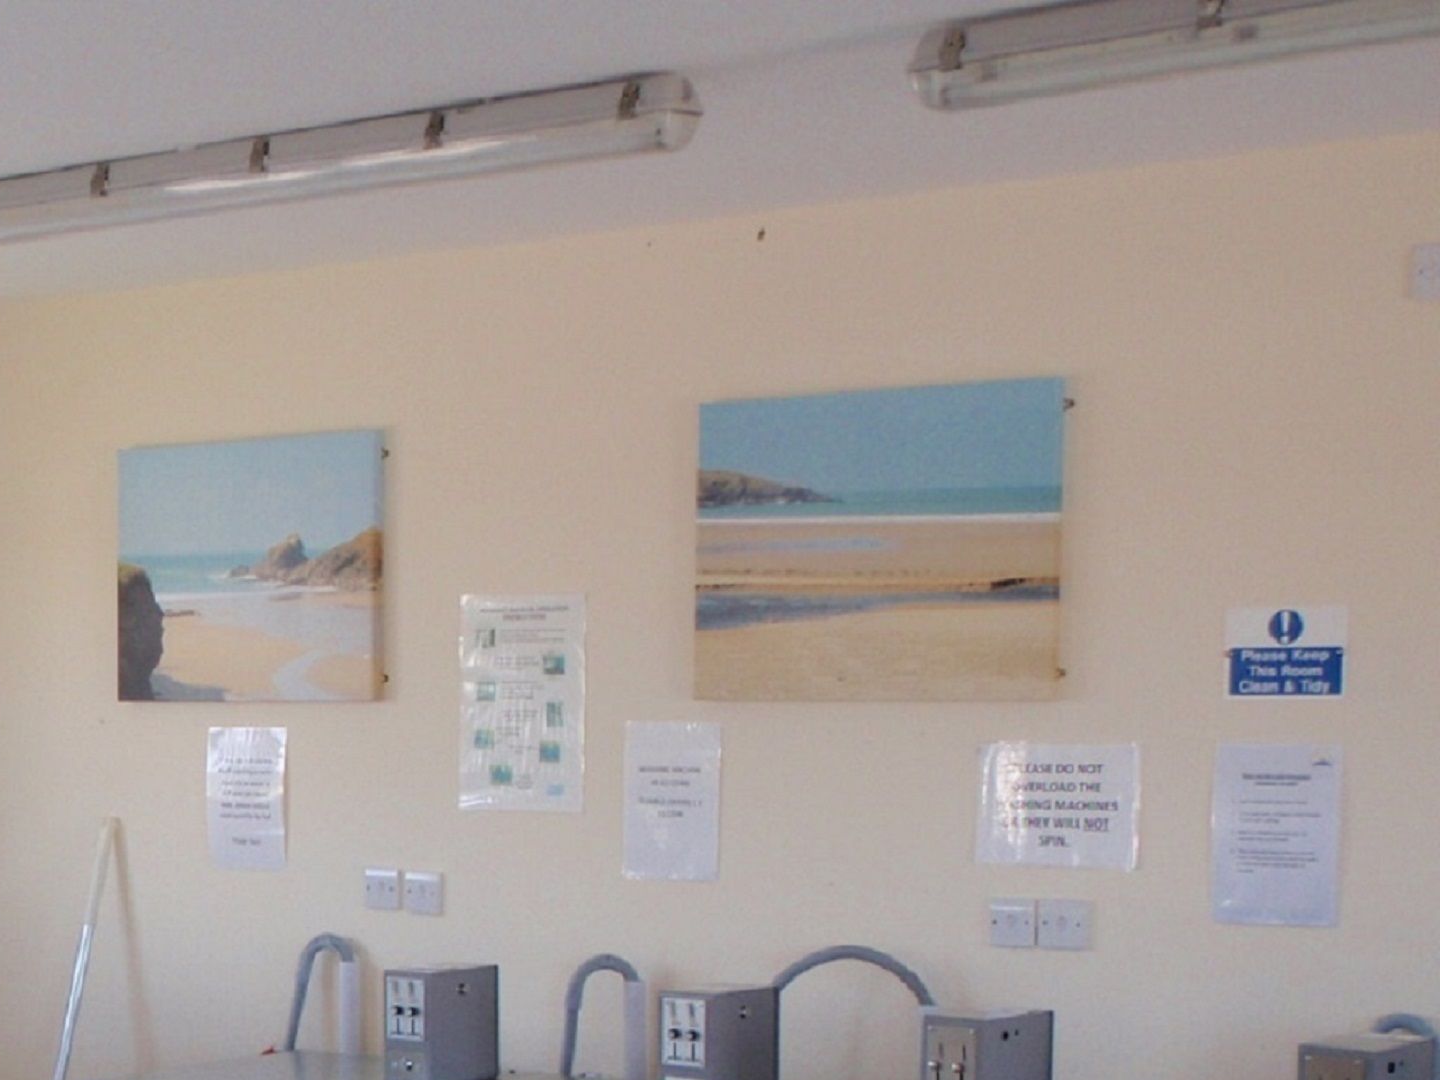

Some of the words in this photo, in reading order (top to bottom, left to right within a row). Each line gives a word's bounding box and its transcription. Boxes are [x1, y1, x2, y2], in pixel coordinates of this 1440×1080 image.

[1240, 650, 1288, 661] Please
[1292, 650, 1330, 663] Keep
[1248, 665, 1277, 677] This
[1280, 664, 1324, 677] Room
[1239, 680, 1279, 693] Clean
[1284, 680, 1297, 693] &
[1300, 680, 1331, 695] Tidy
[1055, 763, 1074, 774] DO
[1078, 763, 1104, 774] NOT
[1079, 781, 1101, 793] THE
[1054, 800, 1119, 812] MACHINES
[1051, 816, 1080, 829] WILL
[1083, 816, 1109, 832] NOT
